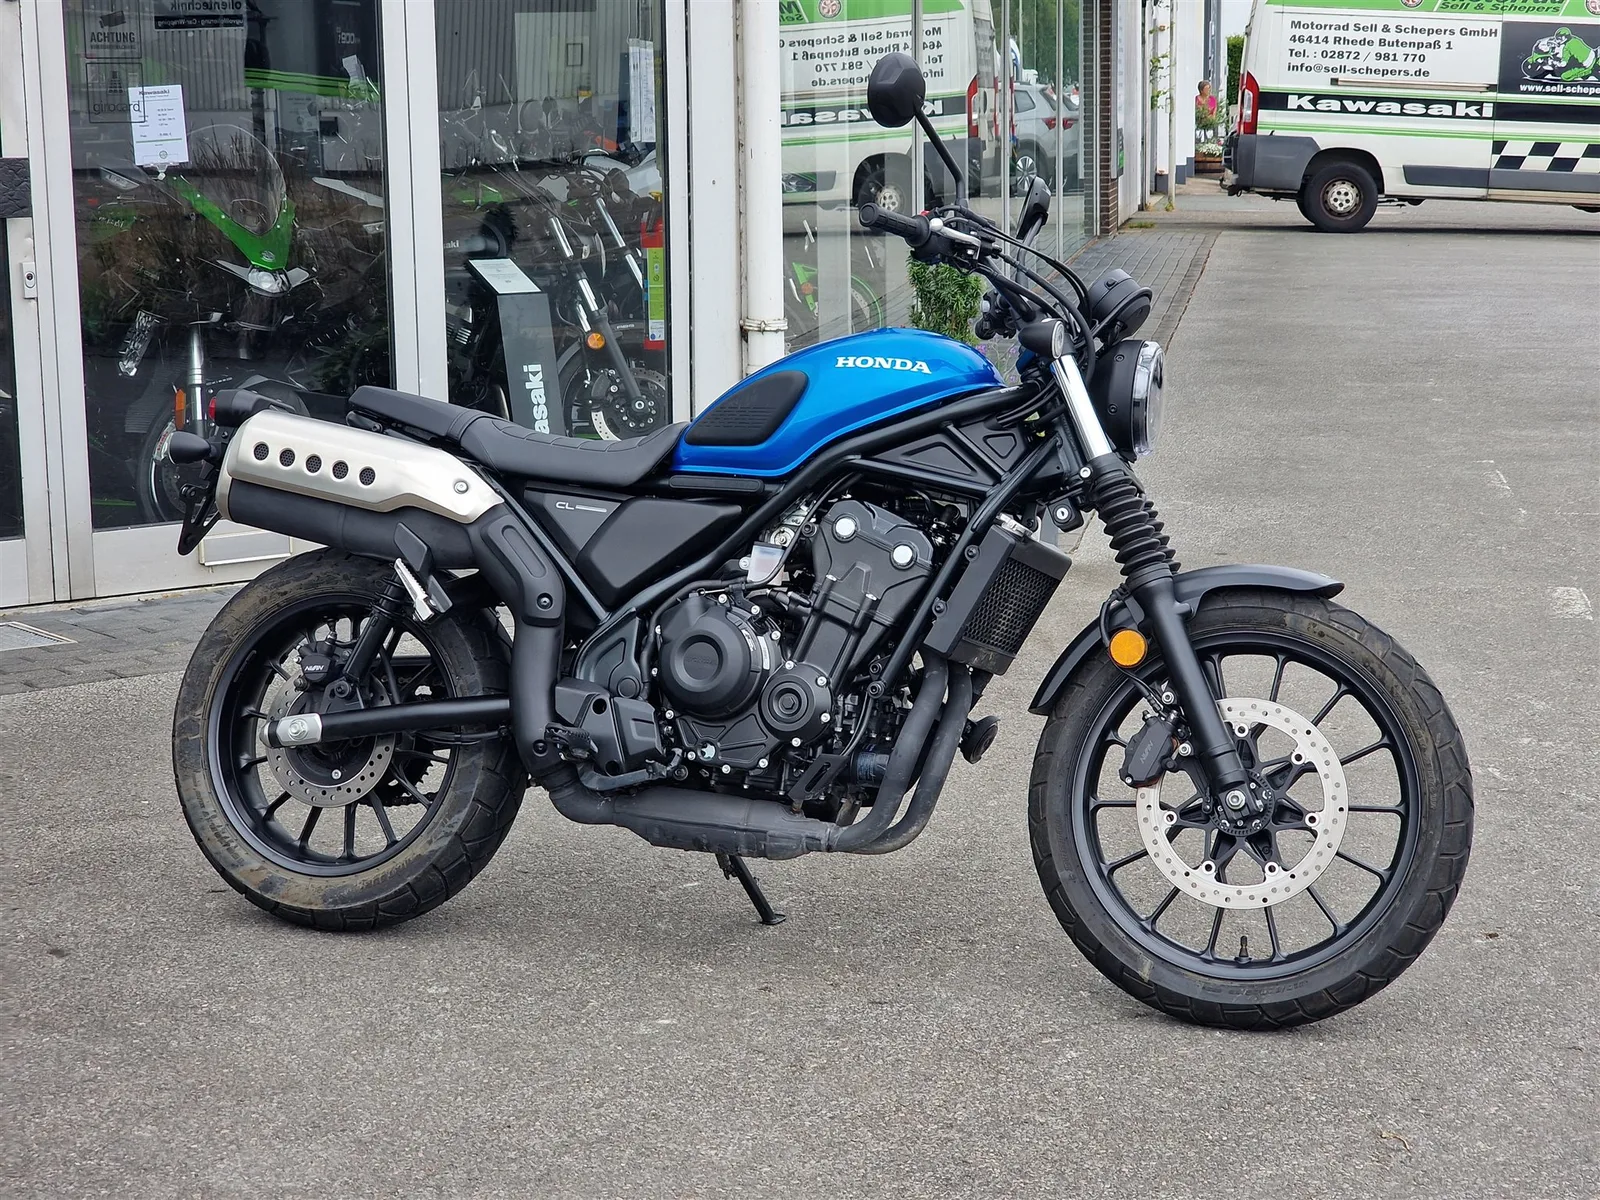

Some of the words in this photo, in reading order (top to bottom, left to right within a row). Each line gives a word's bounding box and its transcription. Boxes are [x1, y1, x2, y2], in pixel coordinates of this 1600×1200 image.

[1440, 1, 1470, 10] Sell
[1474, 2, 1485, 11] &
[1490, 3, 1560, 13] Schepers
[1290, 20, 1350, 32] Motorrad
[1353, 22, 1378, 33] Sell
[1381, 24, 1391, 33] &
[1394, 24, 1456, 37] Schepers
[1459, 27, 1498, 38] GmbH
[90, 31, 136, 43] ACHTUNG
[1289, 34, 1330, 45] 46414
[1333, 36, 1375, 47] Rhede
[1378, 38, 1442, 51] Butenpaß
[1445, 40, 1454, 50] 1
[1288, 48, 1310, 58] Tel.
[1320, 49, 1361, 60] 02872
[1363, 51, 1371, 62] /
[1374, 51, 1399, 62] 981
[1402, 53, 1426, 63] 770
[1287, 62, 1430, 78] info@sell-schepers.de
[93, 100, 142, 115] girocard
[1287, 94, 1494, 118] Kawasaki
[835, 356, 932, 374] HONDA
[556, 501, 575, 510] CL
